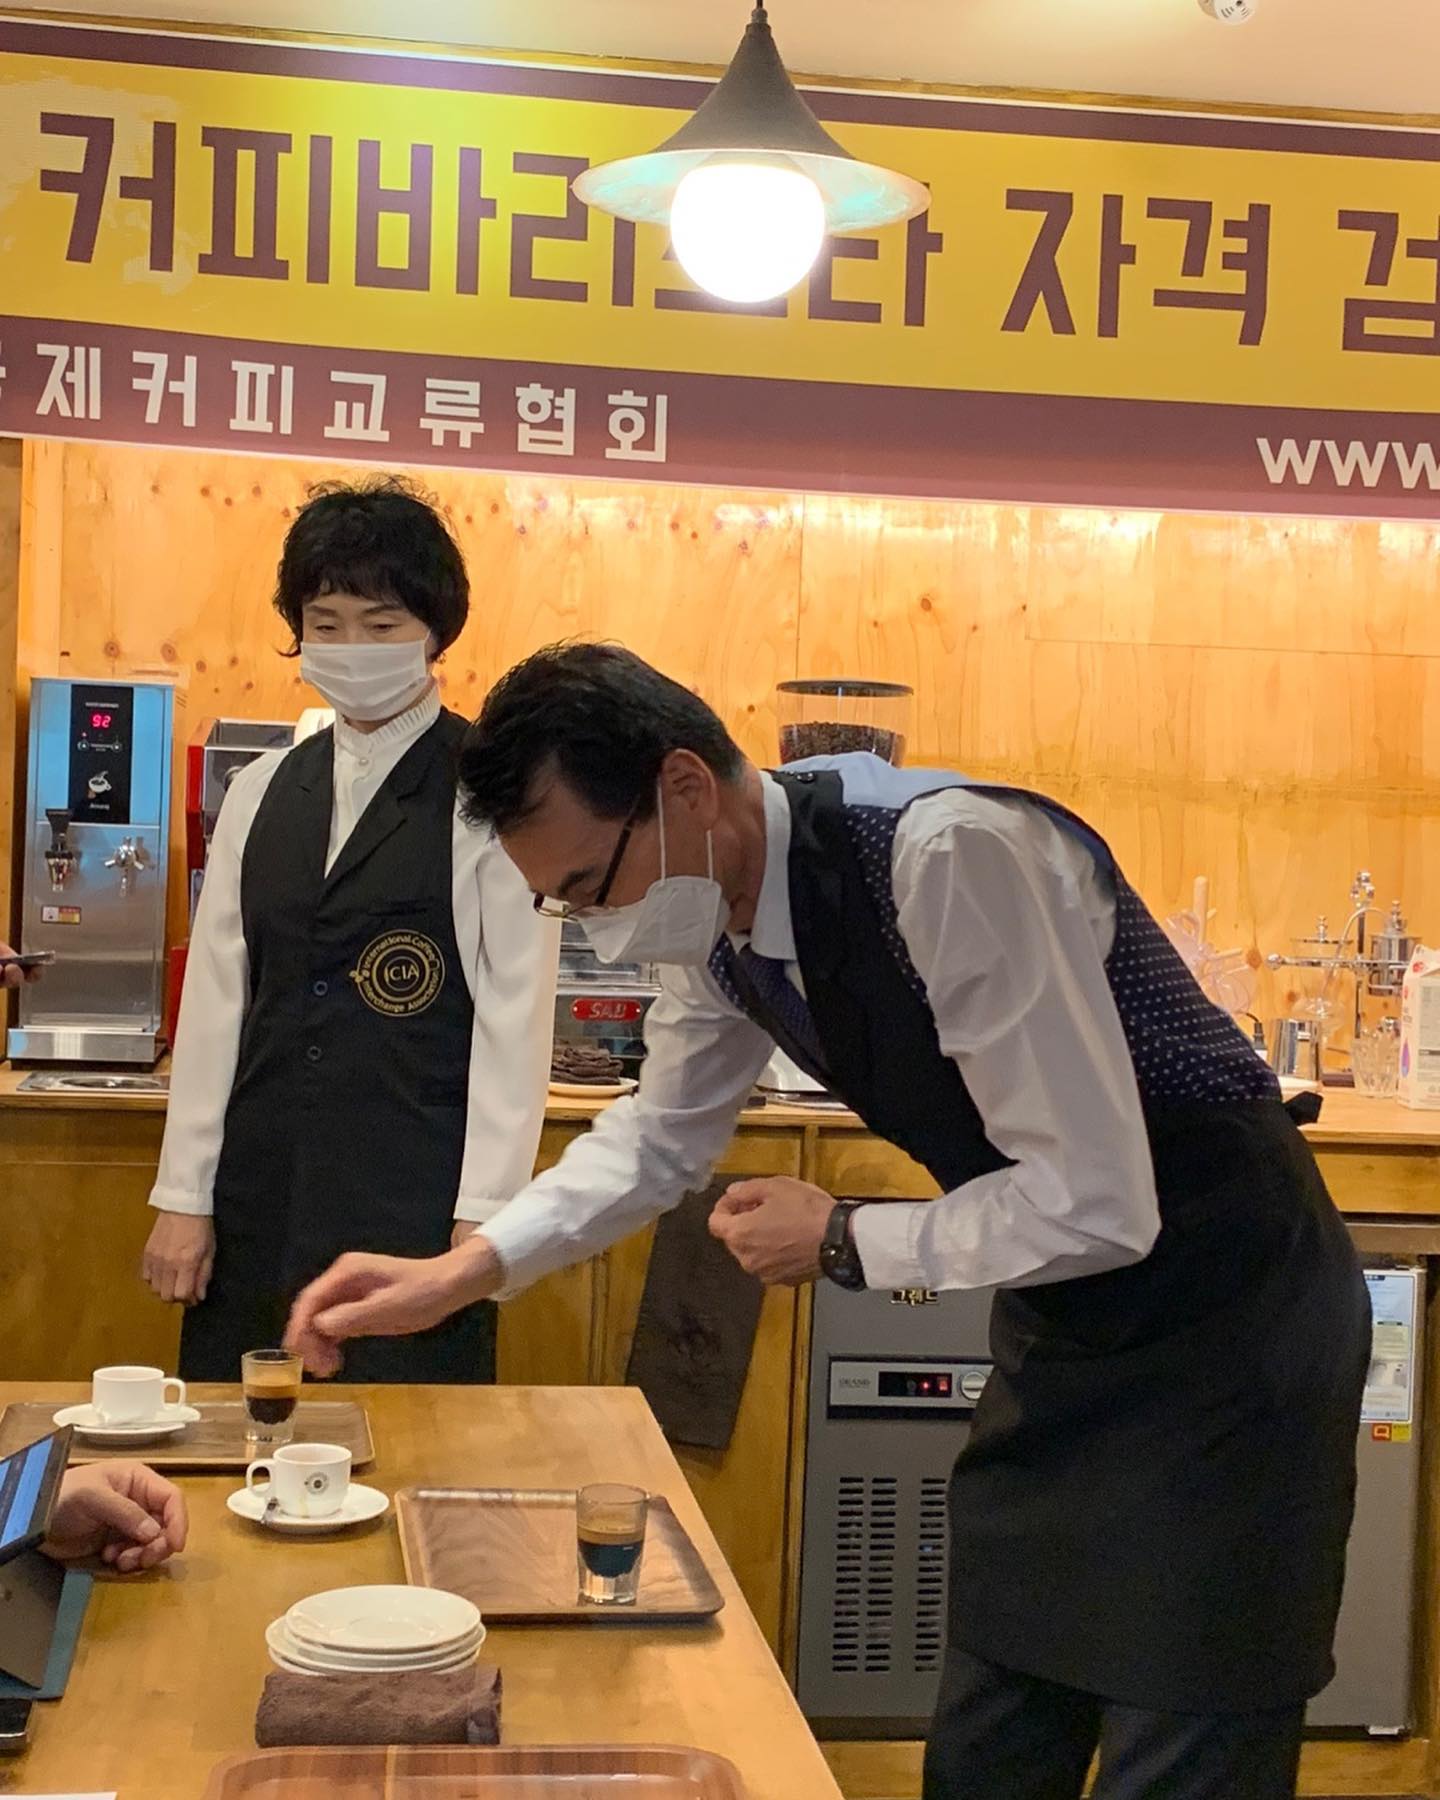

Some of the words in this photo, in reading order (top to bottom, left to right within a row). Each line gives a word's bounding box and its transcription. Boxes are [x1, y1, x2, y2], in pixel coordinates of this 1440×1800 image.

[40, 111, 943, 327] 커피바리타
[1000, 188, 1271, 346] 자격
[0, 343, 668, 463] 제커피교류협회
[389, 964, 419, 981] CIA
